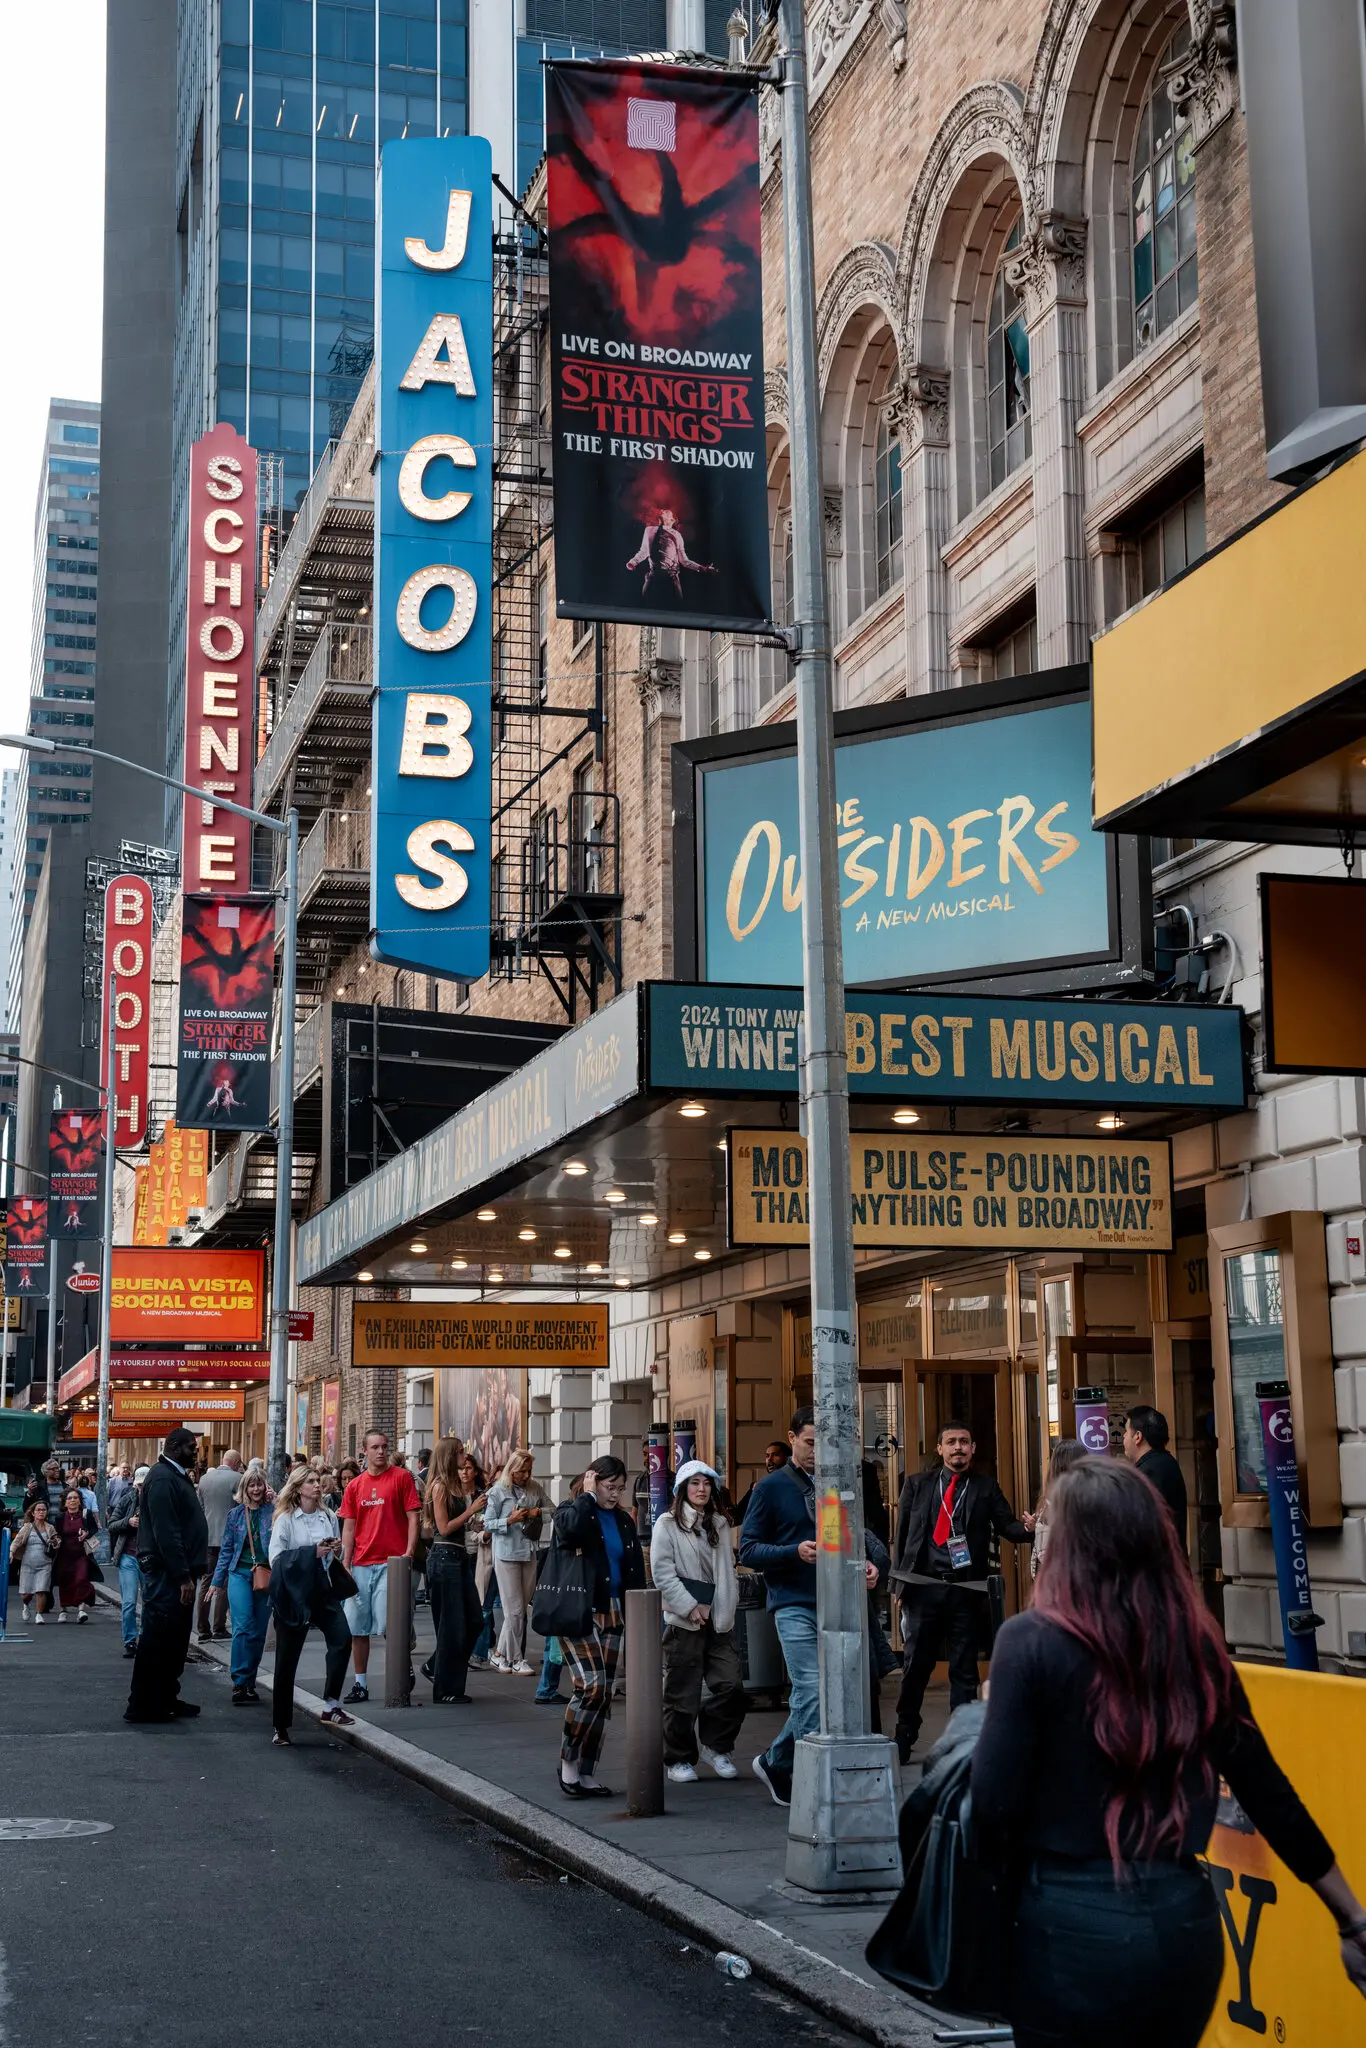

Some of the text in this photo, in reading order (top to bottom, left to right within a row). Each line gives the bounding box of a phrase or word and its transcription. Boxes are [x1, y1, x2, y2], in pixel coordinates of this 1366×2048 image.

[562, 333, 752, 370] LIVE ON BROADWAY
[561, 364, 754, 421] STRANGER
[591, 402, 723, 444] THINGS
[563, 432, 755, 469] THE FIRST SHADOW
[395, 188, 475, 912] JACOBS
[199, 455, 244, 892] SCHOENFE
[855, 892, 1016, 933] A NEW MUSICAL
[112, 887, 145, 1133] BOOTH
[183, 1009, 268, 1019] LIVE ON BROADWAY
[681, 1005, 721, 1026] 2024
[725, 1006, 769, 1028] TONY
[183, 1022, 267, 1040] STRANGER
[196, 1037, 254, 1051] THINGS
[681, 1026, 797, 1072] WINNE
[845, 1011, 1215, 1086] BEST MUSICAL
[183, 1050, 267, 1061] THE FIRST SHADOW
[454, 1067, 552, 1182] BEST MUSICAL
[170, 1136, 183, 1211] SOCIAL
[188, 1129, 204, 1177] LUB
[738, 1146, 1151, 1195] “MO PULSE-POUNDING
[151, 1163, 165, 1225] VISTA
[851, 1193, 962, 1228] NYTHING
[973, 1196, 1007, 1228] ON
[111, 1278, 254, 1292] BUENA VISTA
[111, 1294, 254, 1310] SOCIAL CLUB
[365, 1334, 400, 1350] WITH
[404, 1334, 491, 1350] HIGH-OCTANE
[385, 1319, 468, 1334] EXHILARATING
[472, 1319, 513, 1334] WORLD
[516, 1320, 530, 1334] OF
[534, 1320, 597, 1335] MOVEMENT
[121, 1400, 236, 1410] WINNER! 5 TONY AWARDS
[1284, 1489, 1309, 1604] WELCOME
